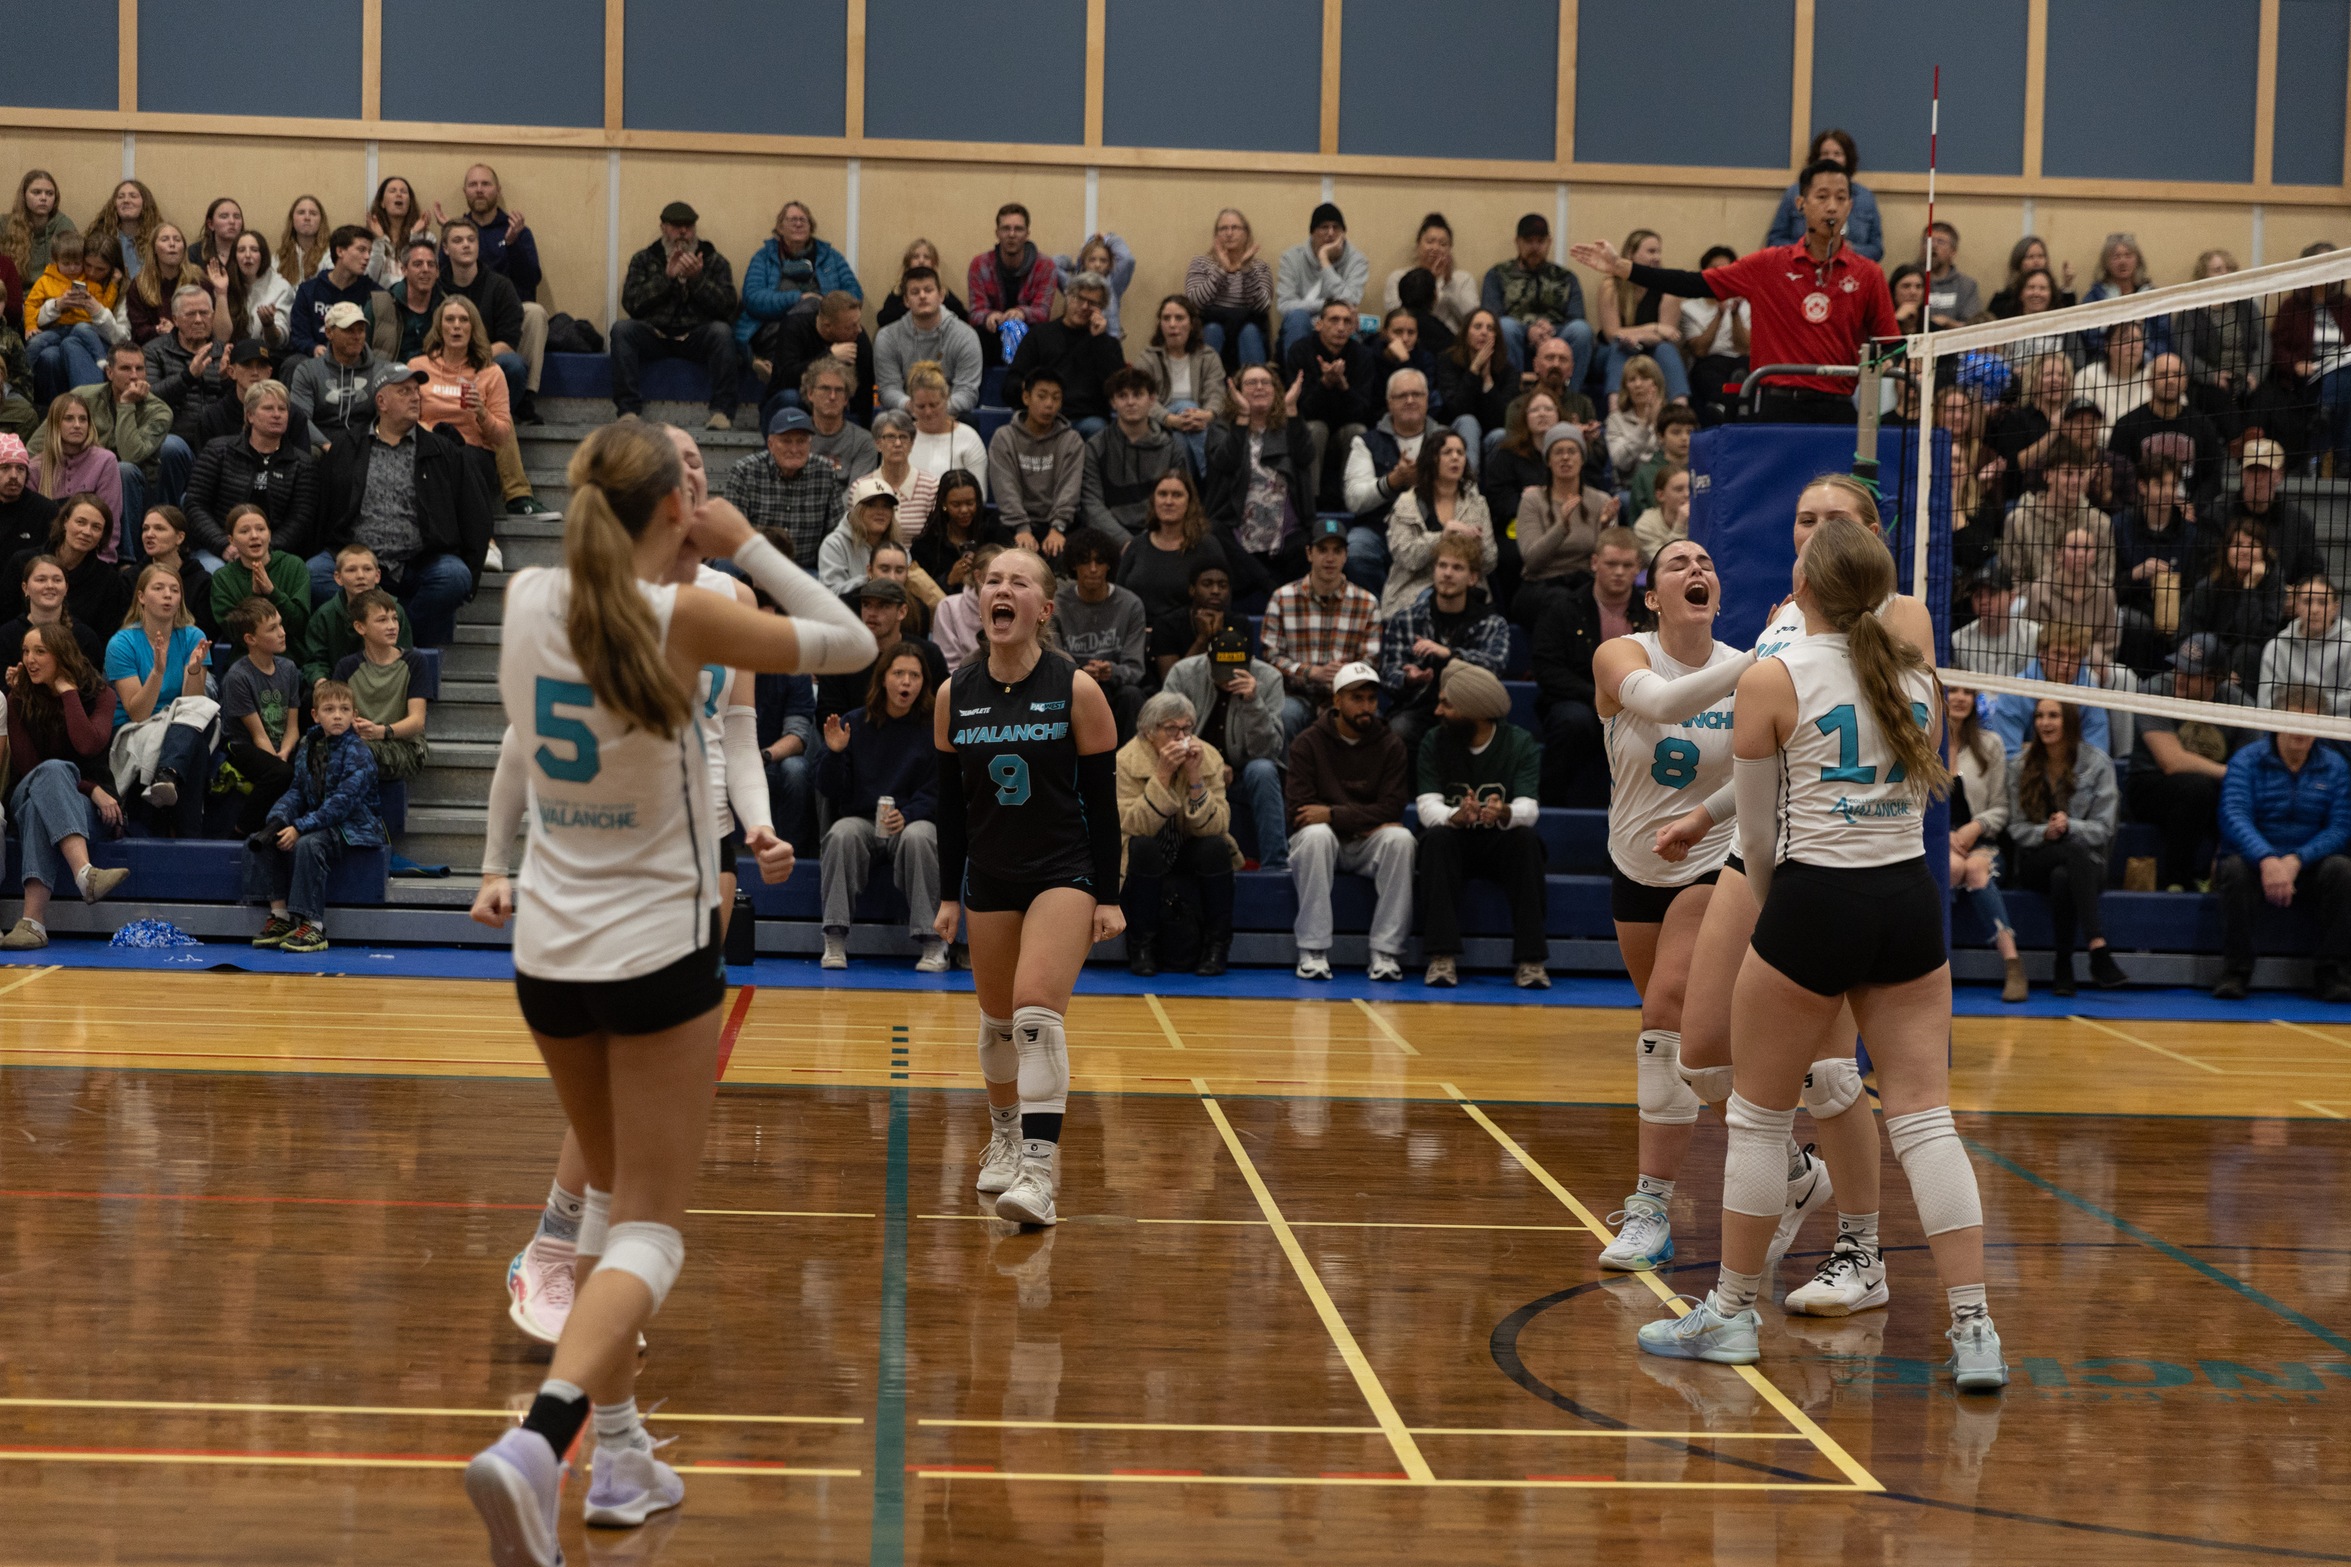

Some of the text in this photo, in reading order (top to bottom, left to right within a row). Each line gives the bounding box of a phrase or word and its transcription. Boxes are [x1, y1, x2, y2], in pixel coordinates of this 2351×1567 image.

[535, 675, 600, 784] 5
[953, 722, 1069, 744] AVALANCHE
[987, 753, 1031, 806] 9
[1650, 736, 1700, 790] 8
[539, 805, 641, 833] VALANCHE
[1828, 796, 1912, 824] AVALANCHE
